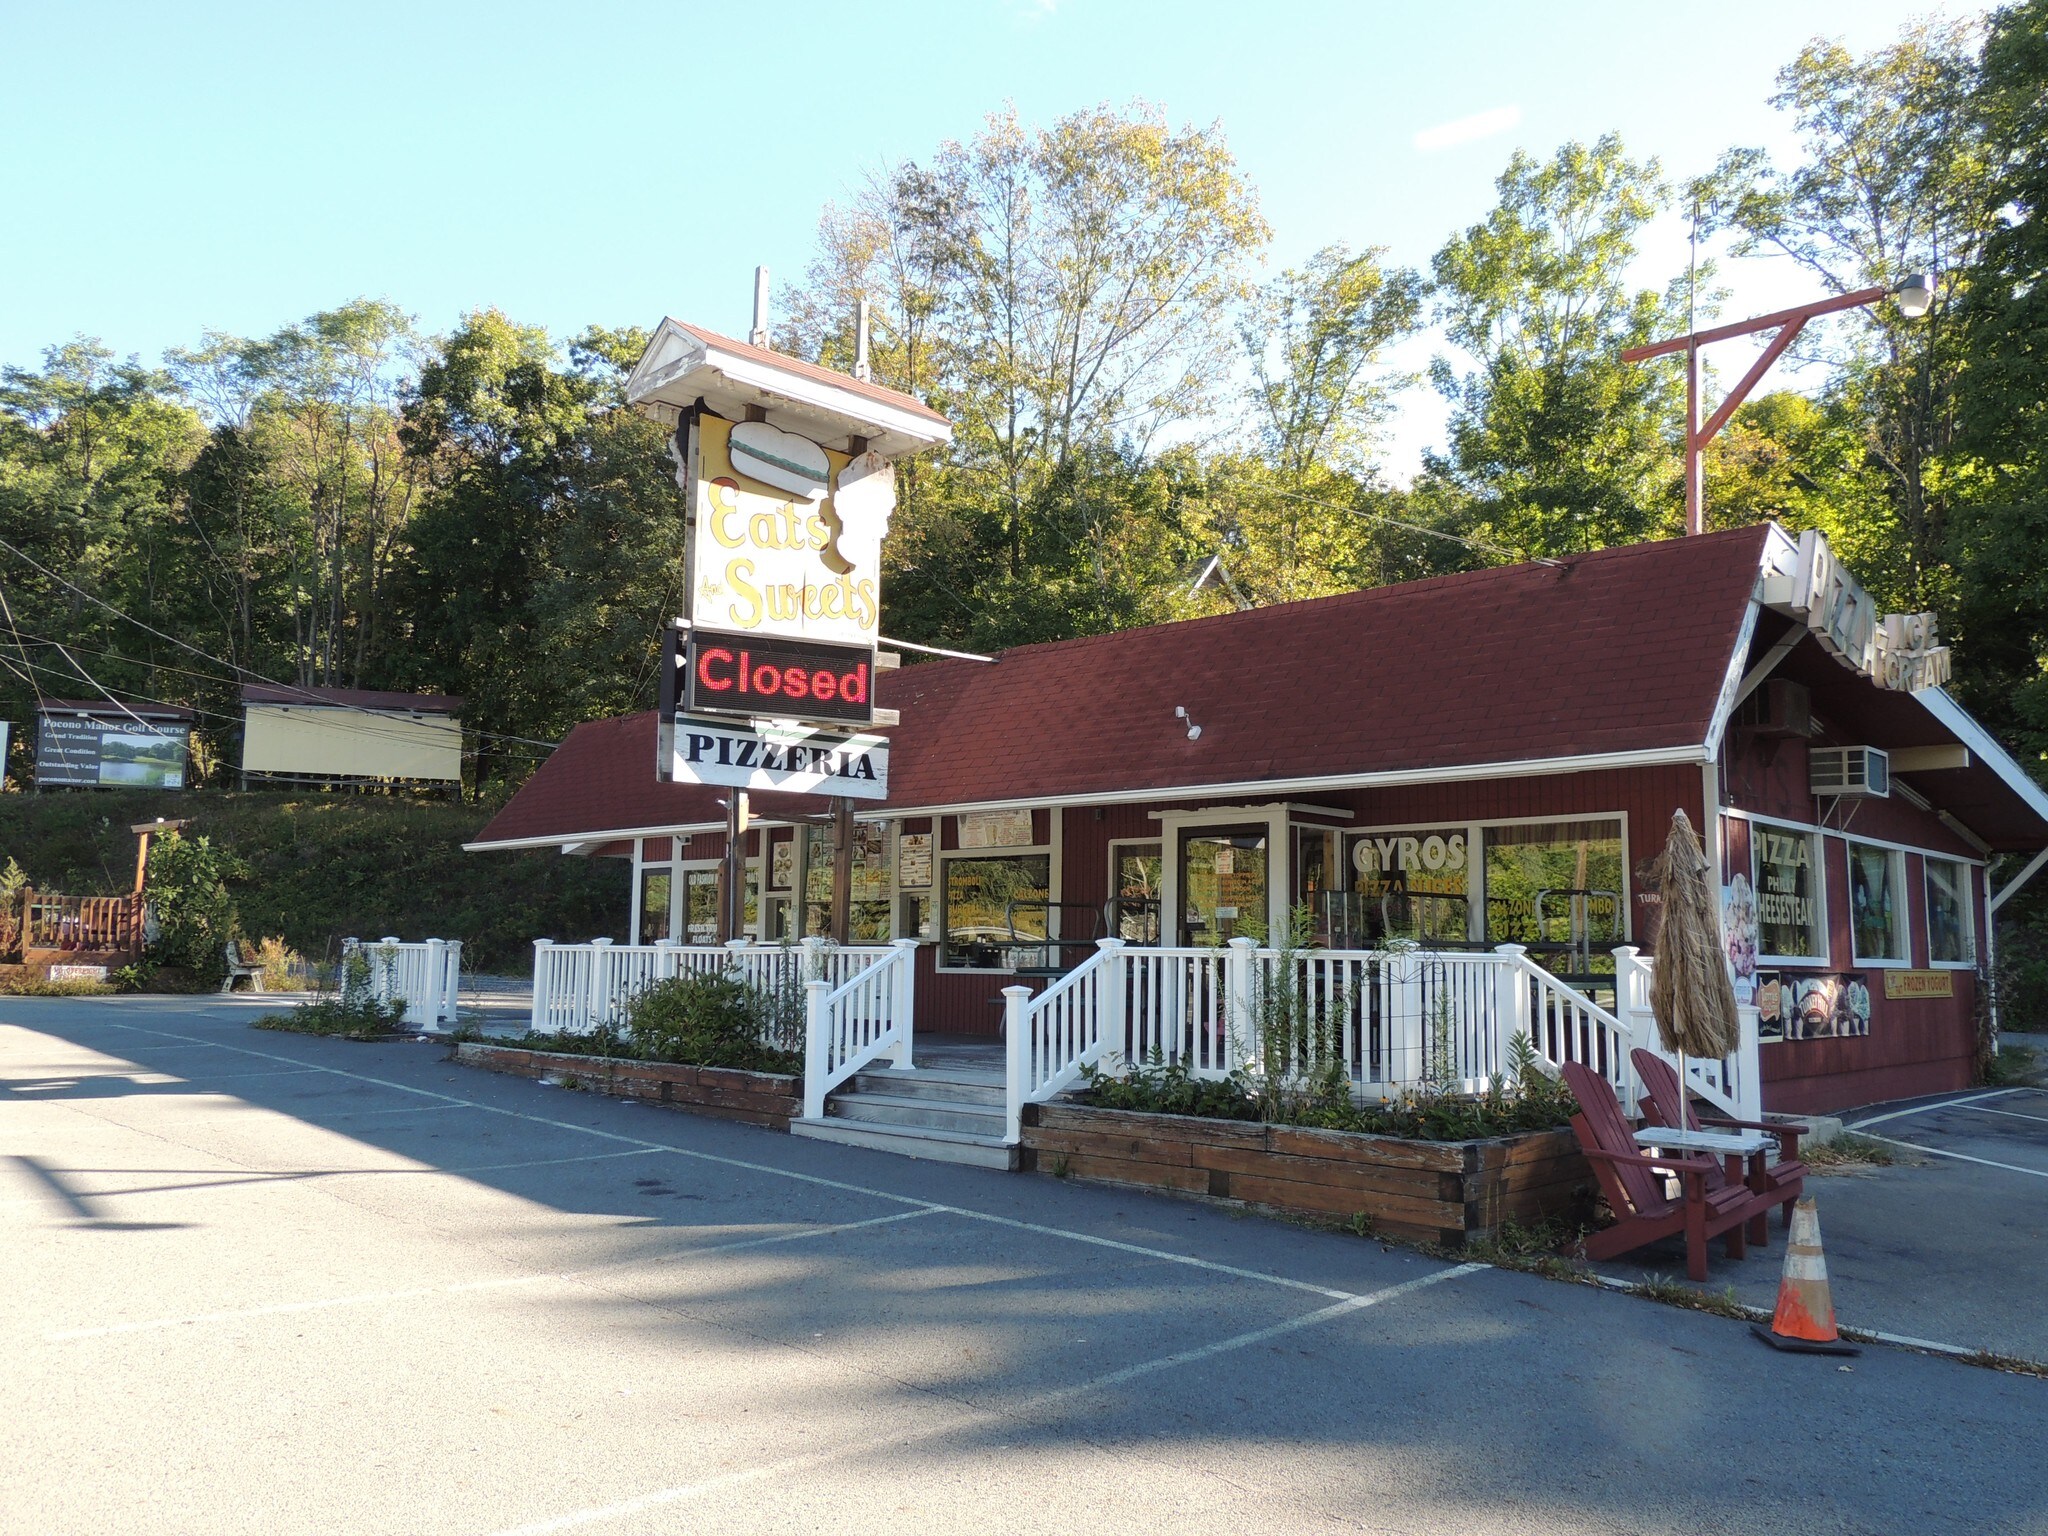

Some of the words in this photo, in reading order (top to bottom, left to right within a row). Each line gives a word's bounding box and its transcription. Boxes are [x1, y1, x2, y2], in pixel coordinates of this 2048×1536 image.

[708, 477, 831, 552] Eats
[725, 557, 878, 630] Sweets
[1884, 612, 1938, 650] ICE
[699, 648, 868, 703] Closed
[1884, 646, 1951, 692] CREAM
[44, 718, 81, 729] Pocono
[84, 720, 119, 731] Manor
[122, 722, 146, 733] Golf
[148, 724, 186, 734] Course
[44, 732, 66, 740] Grand
[68, 733, 98, 741] Tradition
[39, 761, 79, 770] Outstanding
[80, 762, 99, 770] Value
[65, 747, 96, 755] Condition
[685, 733, 878, 781] PIZZERIA
[1352, 834, 1465, 872] GYROS
[1753, 830, 1811, 869] PIZZA
[1355, 879, 1404, 898] PIZZA
[1638, 892, 1664, 904] TURK
[1757, 892, 1814, 927] HEESESTEAK
[1903, 975, 1926, 992] FROZEN
[1927, 975, 1949, 992] YOGURT
